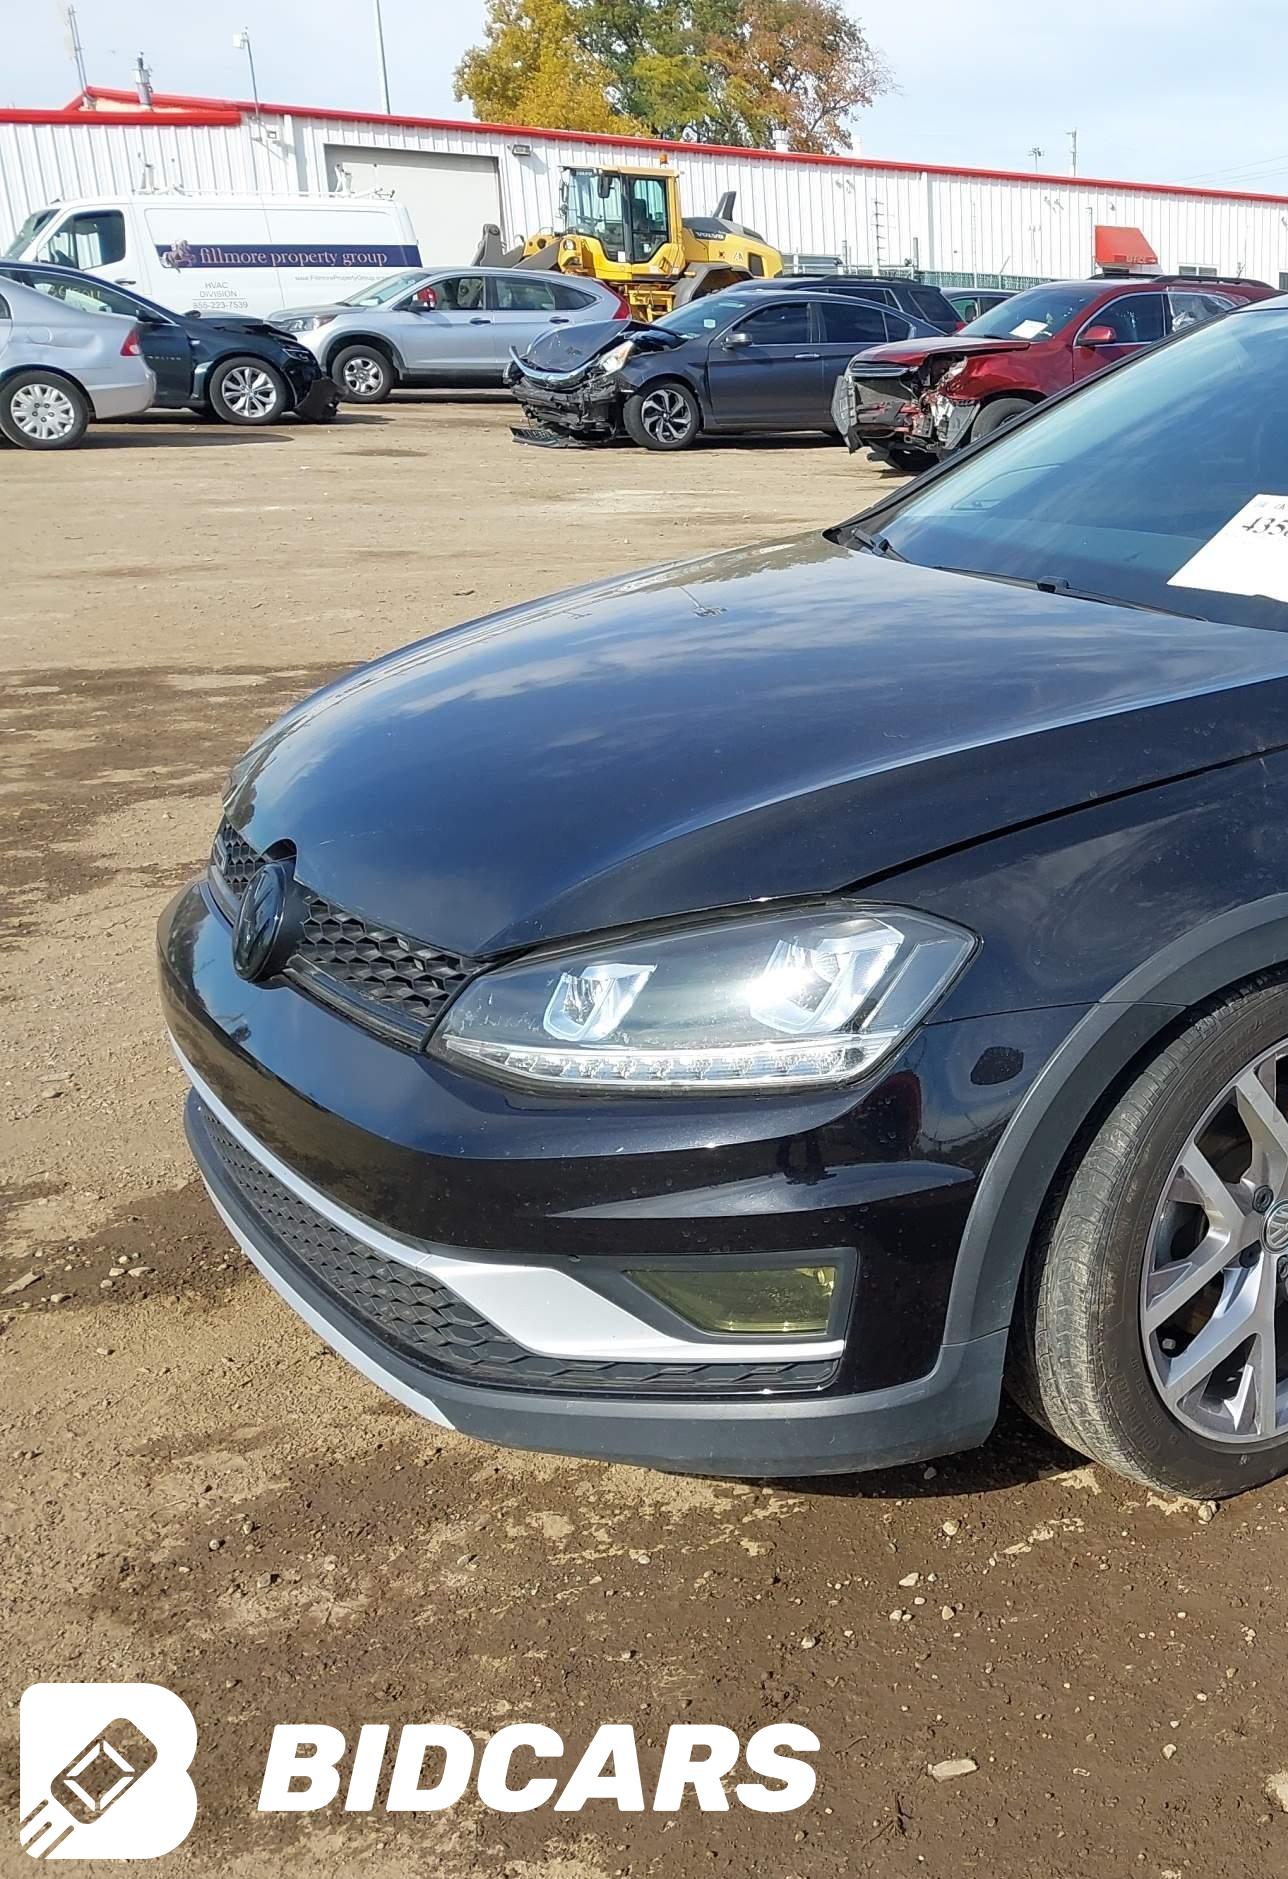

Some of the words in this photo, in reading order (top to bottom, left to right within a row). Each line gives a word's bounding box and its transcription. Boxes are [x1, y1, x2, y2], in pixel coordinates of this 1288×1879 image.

[200, 247, 266, 264] fillmore
[272, 249, 337, 267] property
[342, 251, 388, 266] group
[204, 281, 229, 289] HVAC
[199, 290, 237, 298] DIVISION
